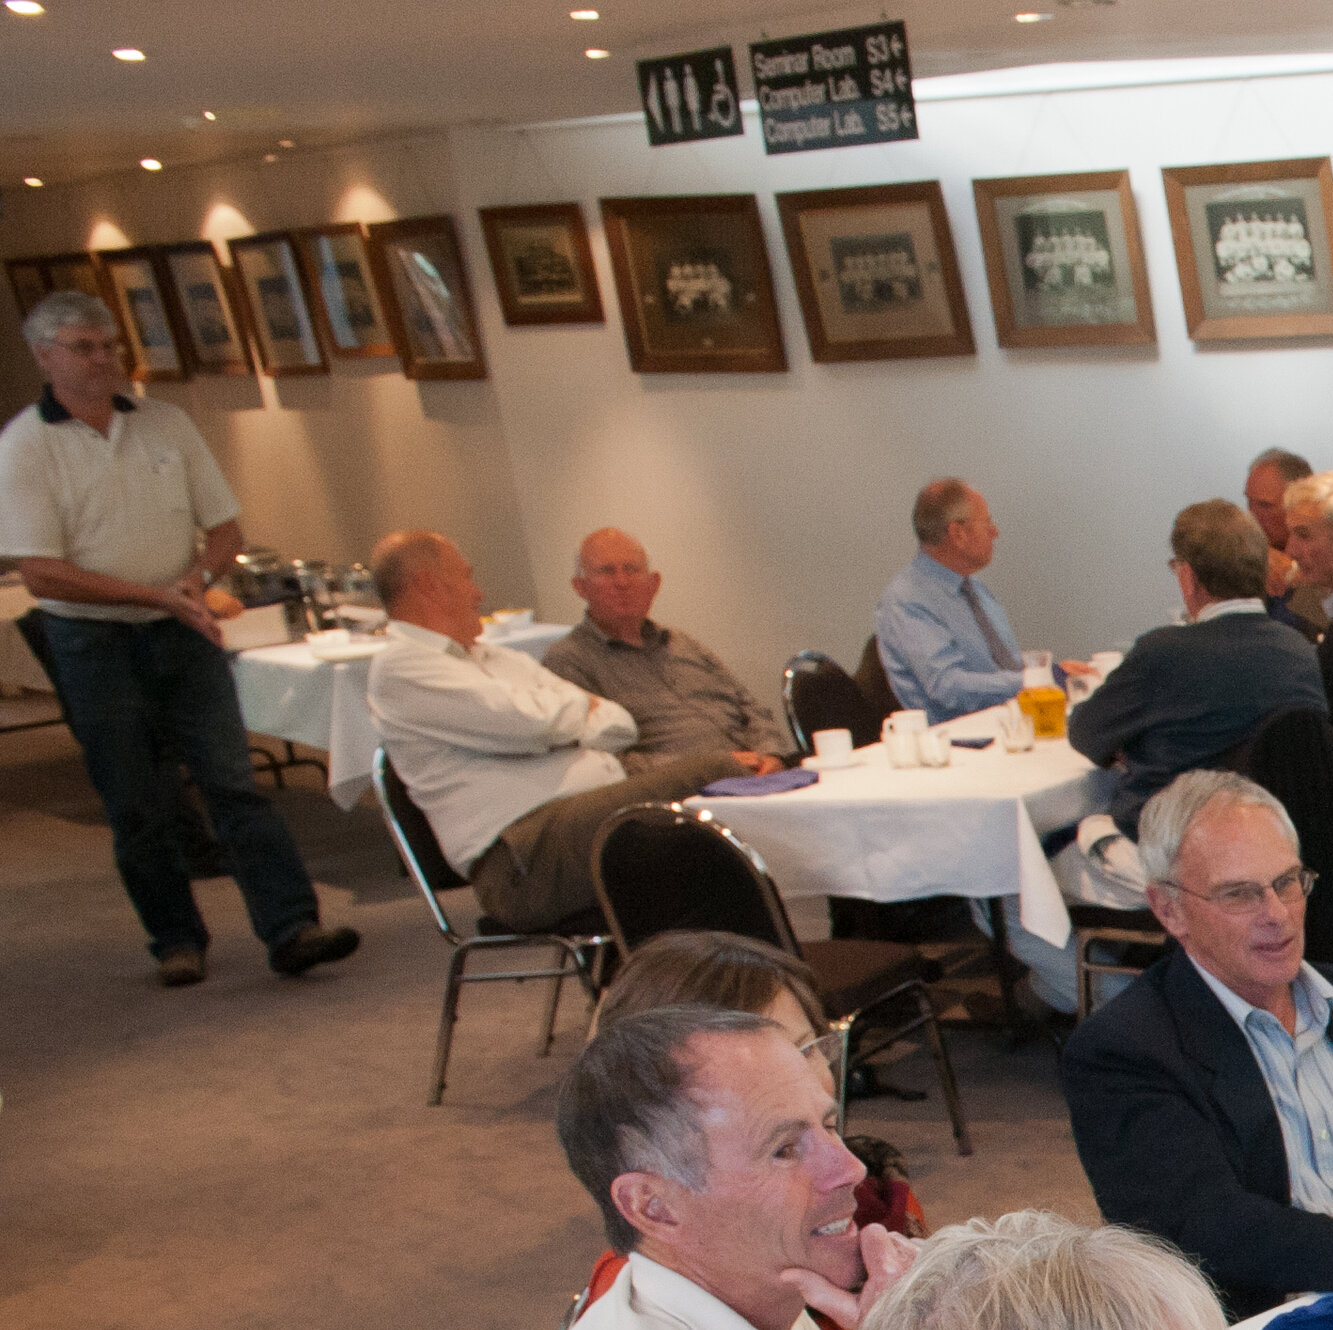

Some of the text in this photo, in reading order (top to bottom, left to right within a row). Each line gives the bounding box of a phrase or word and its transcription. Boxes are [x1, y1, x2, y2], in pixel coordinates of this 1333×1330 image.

[754, 50, 809, 79] Seminar
[811, 43, 858, 71] Room
[760, 80, 827, 111] Computer
[870, 68, 894, 97] S4
[765, 113, 831, 146] Computer
